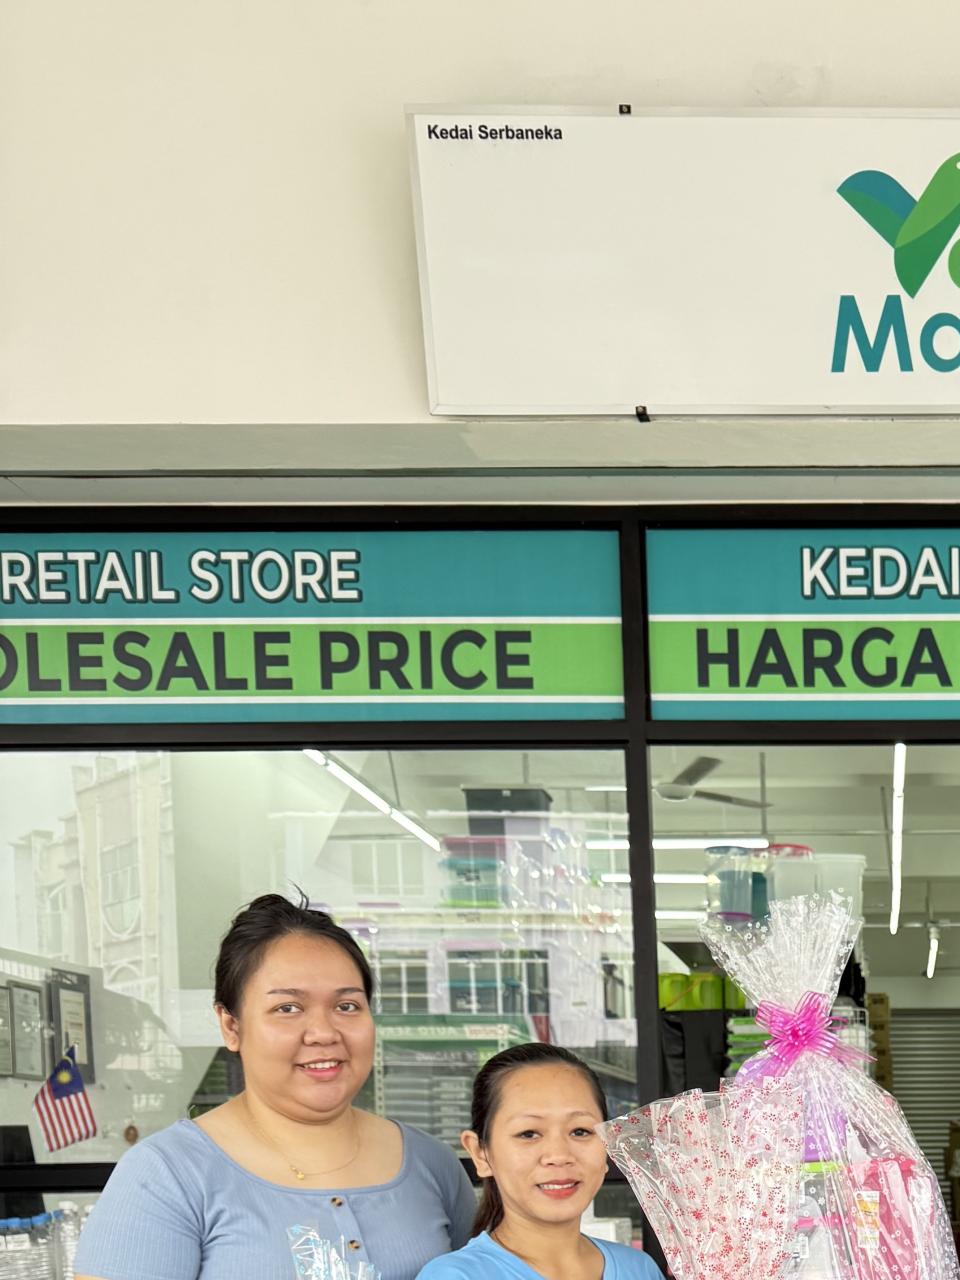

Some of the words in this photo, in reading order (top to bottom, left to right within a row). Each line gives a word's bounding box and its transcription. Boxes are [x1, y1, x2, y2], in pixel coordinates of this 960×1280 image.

[427, 124, 473, 141] Kedai
[478, 124, 563, 141] Serbaneka
[0, 550, 180, 604] RETAIL
[190, 549, 362, 603] STORE
[319, 630, 534, 692] PRICE
[696, 627, 953, 689] HARGA
